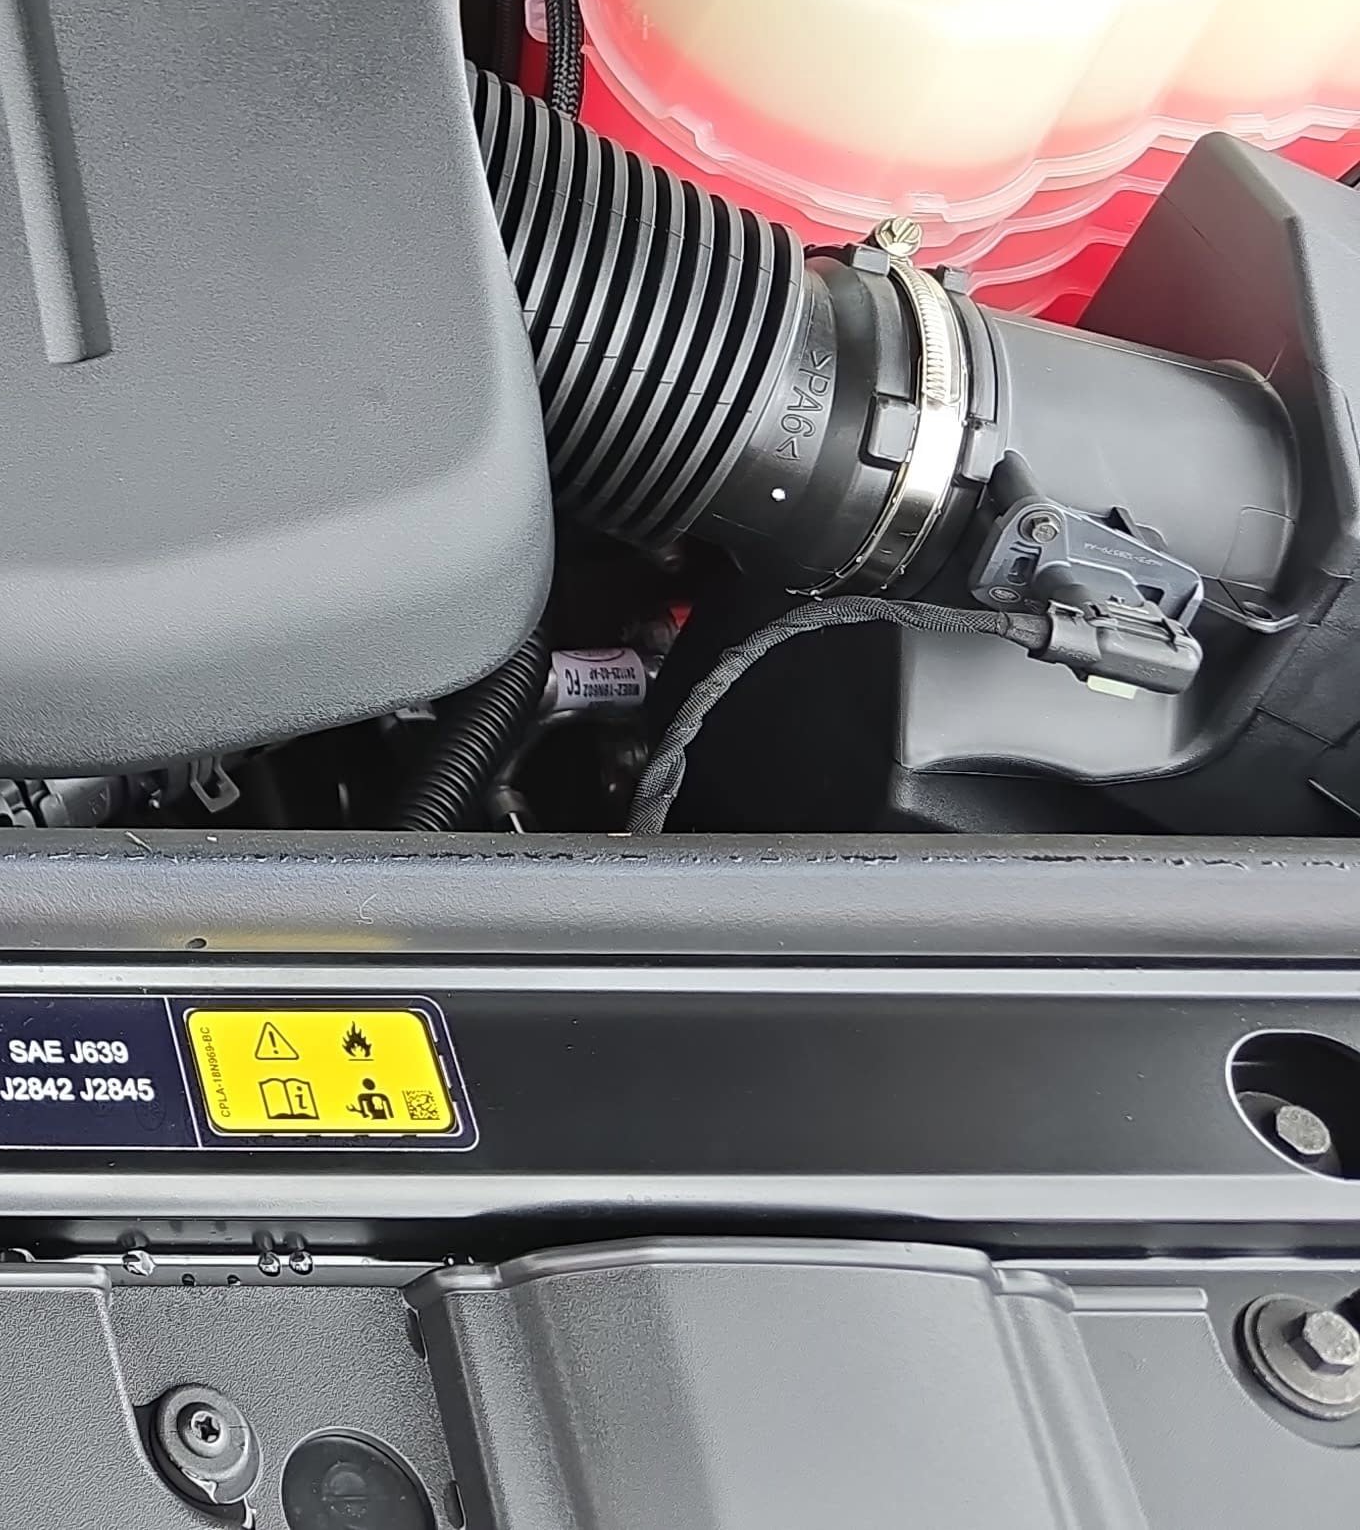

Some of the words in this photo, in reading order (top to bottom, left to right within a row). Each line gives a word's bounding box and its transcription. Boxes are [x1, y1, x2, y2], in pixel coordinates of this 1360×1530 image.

[8, 1039, 65, 1064] SAE
[69, 1040, 129, 1064] J639
[200, 1026, 232, 1119] CPLA-18N969-BC
[0, 1076, 76, 1101] J2842
[80, 1077, 156, 1102] J2845
